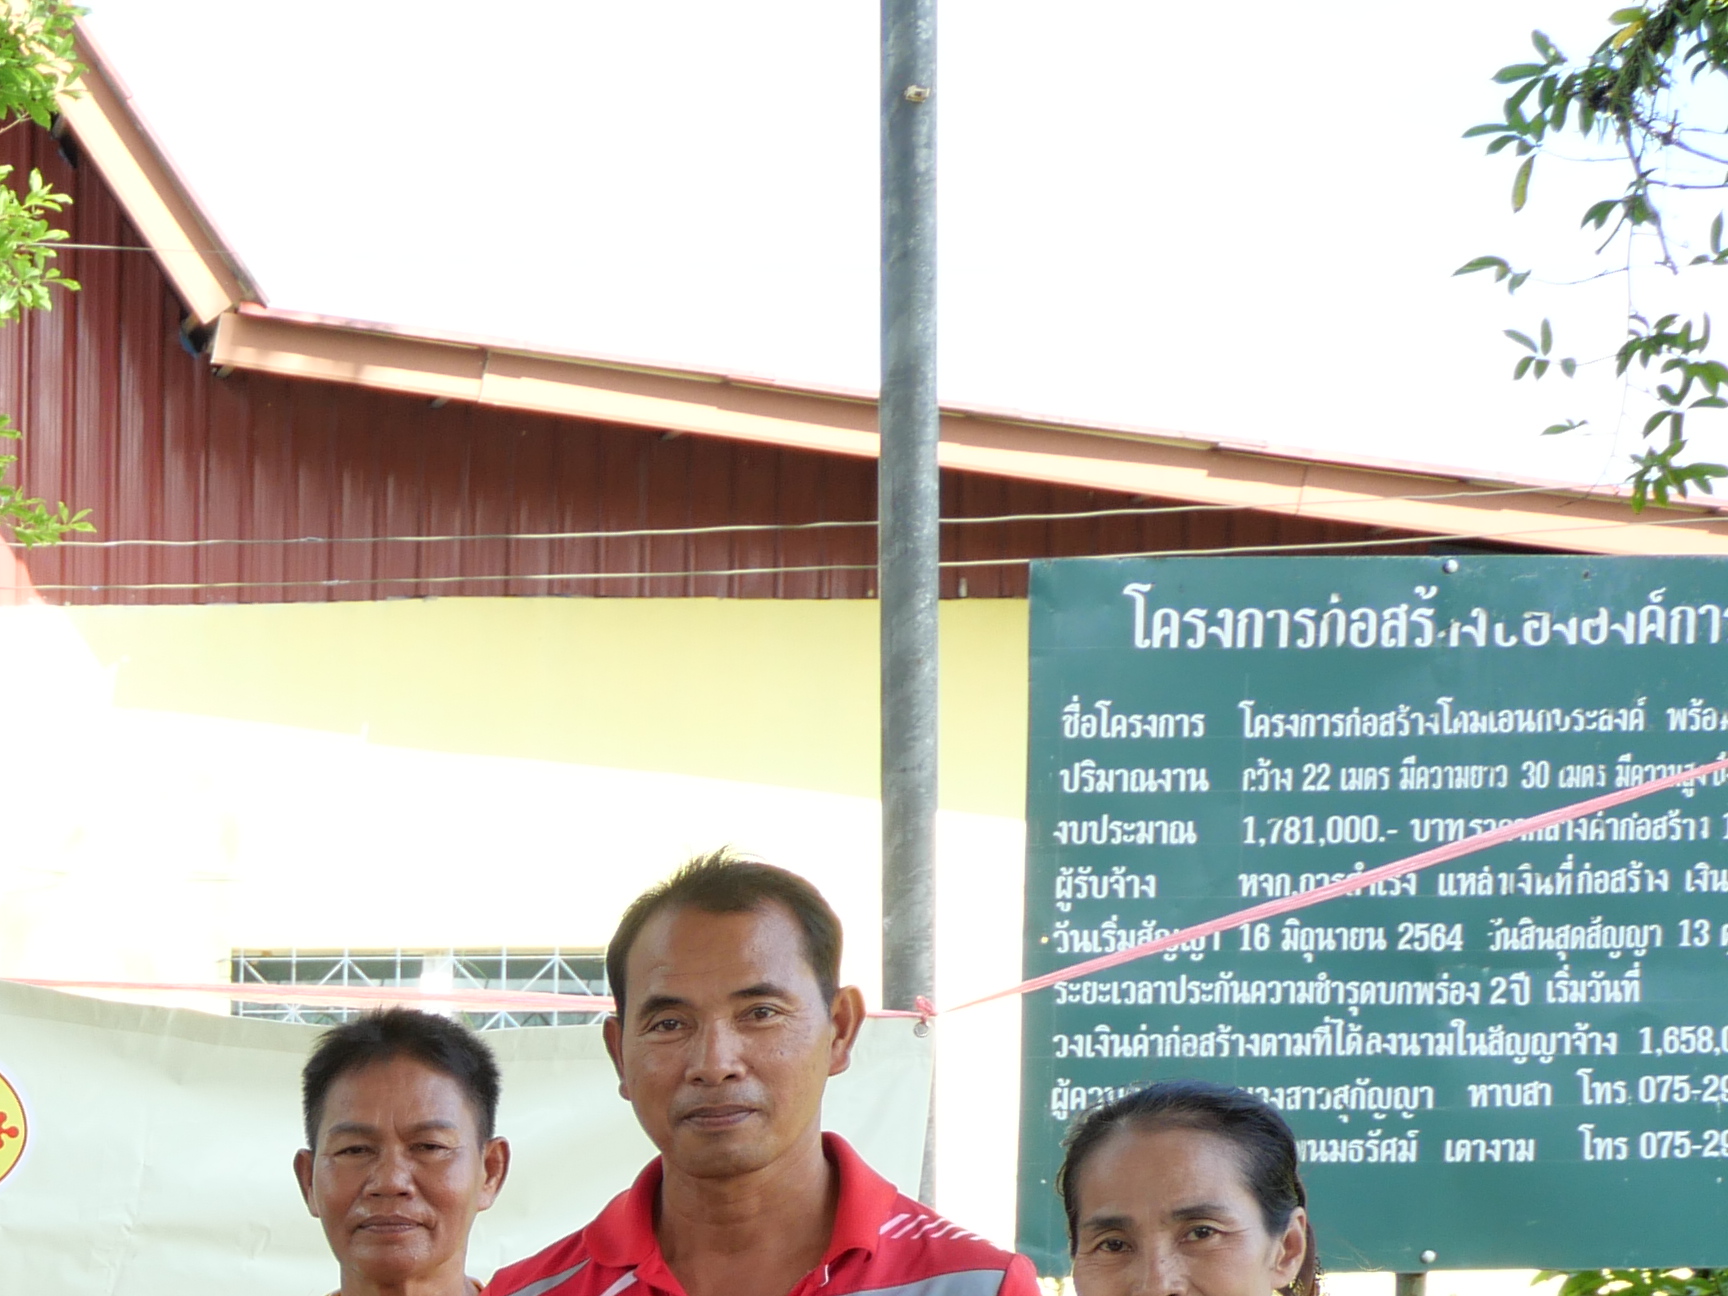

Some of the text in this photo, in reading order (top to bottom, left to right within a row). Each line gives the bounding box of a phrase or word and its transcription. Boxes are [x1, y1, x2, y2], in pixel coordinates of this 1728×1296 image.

[1061, 694, 1206, 739] ชื่อโครงการ
[1059, 758, 1211, 793] ปริมาณงาน
[1301, 763, 1331, 791] 22
[1520, 760, 1550, 789] 30
[1052, 814, 1197, 845] งบประมาณ
[1054, 866, 1157, 912] ผู้รับจ้าง
[1239, 923, 1271, 950] 16
[1281, 918, 1388, 963] มิถุนายน
[1397, 922, 1463, 951] 2564
[1678, 919, 1711, 947] 13
[1546, 961, 1642, 1004] เริ่มวันที่
[1578, 1123, 1628, 1162] โทร
